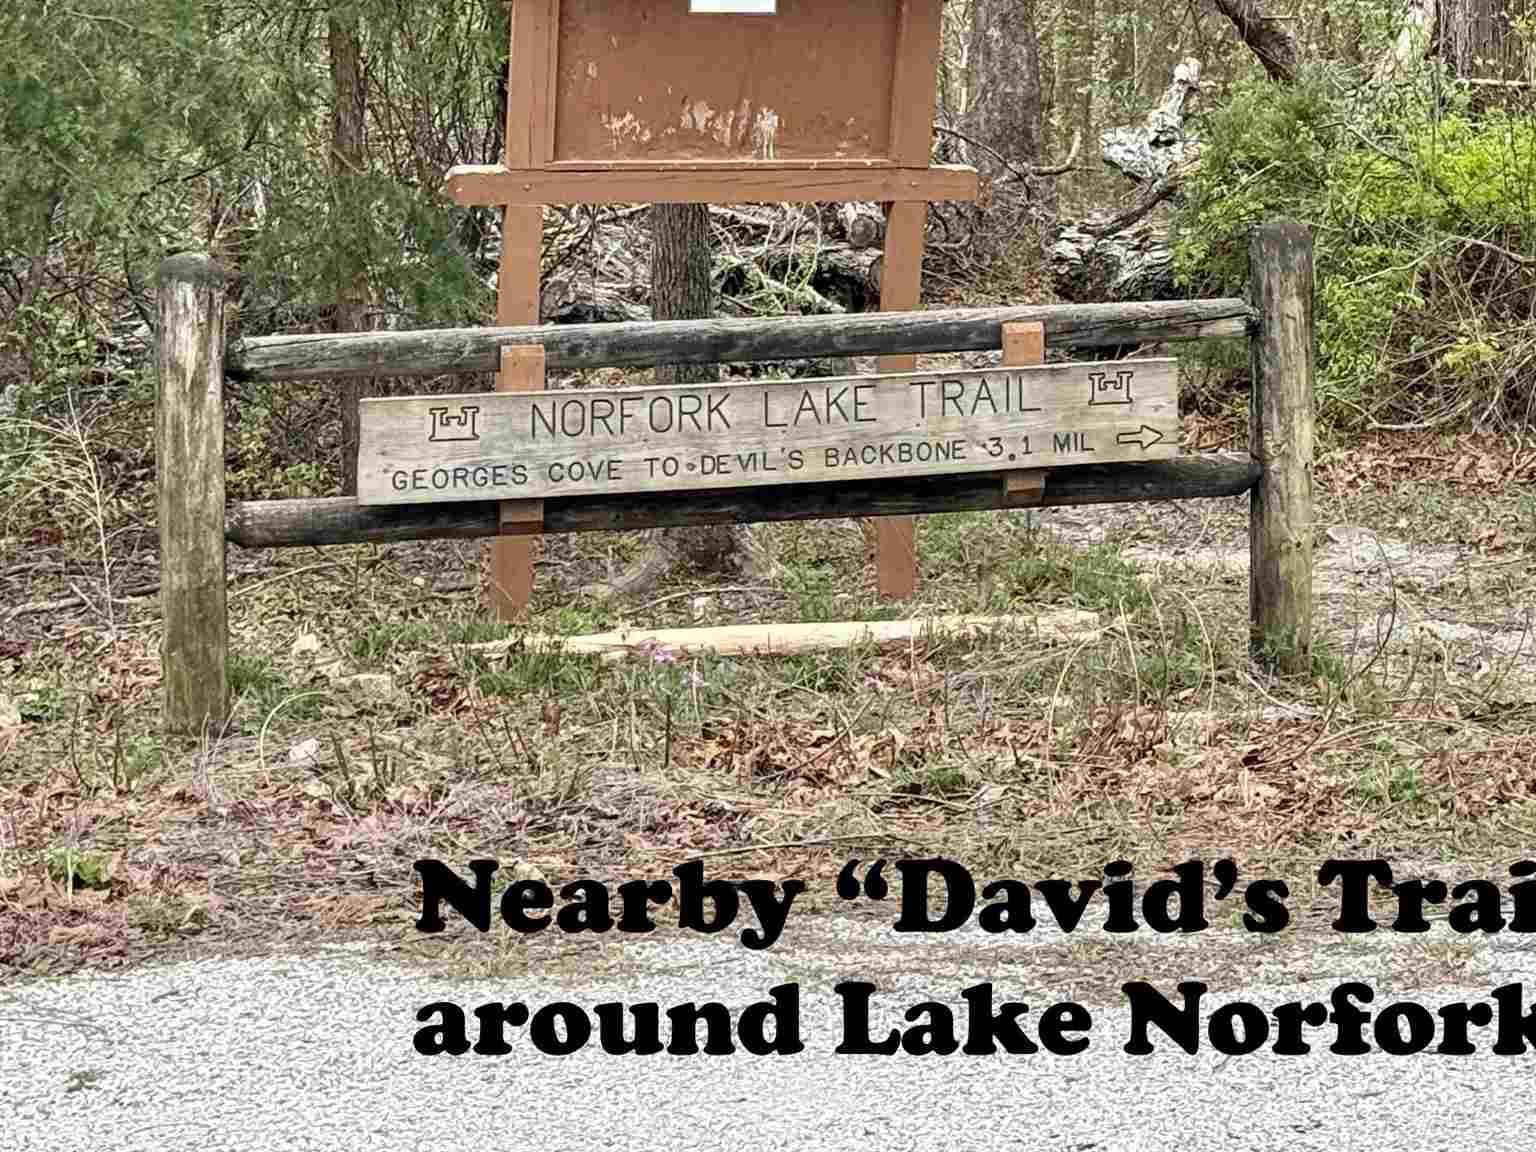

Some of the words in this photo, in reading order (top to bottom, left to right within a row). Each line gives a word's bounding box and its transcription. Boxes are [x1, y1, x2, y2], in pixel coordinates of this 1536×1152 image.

[530, 391, 732, 440] NORFORK
[764, 384, 878, 429] LAKE
[909, 375, 1042, 418] TRAIL
[391, 464, 529, 491] GEORGES
[548, 460, 624, 483] COVE
[643, 456, 680, 478] TO
[700, 447, 805, 476] DEVIL'S
[824, 439, 967, 467] BACKBONE
[987, 434, 1033, 461] 3.1
[1052, 431, 1096, 454] MIL
